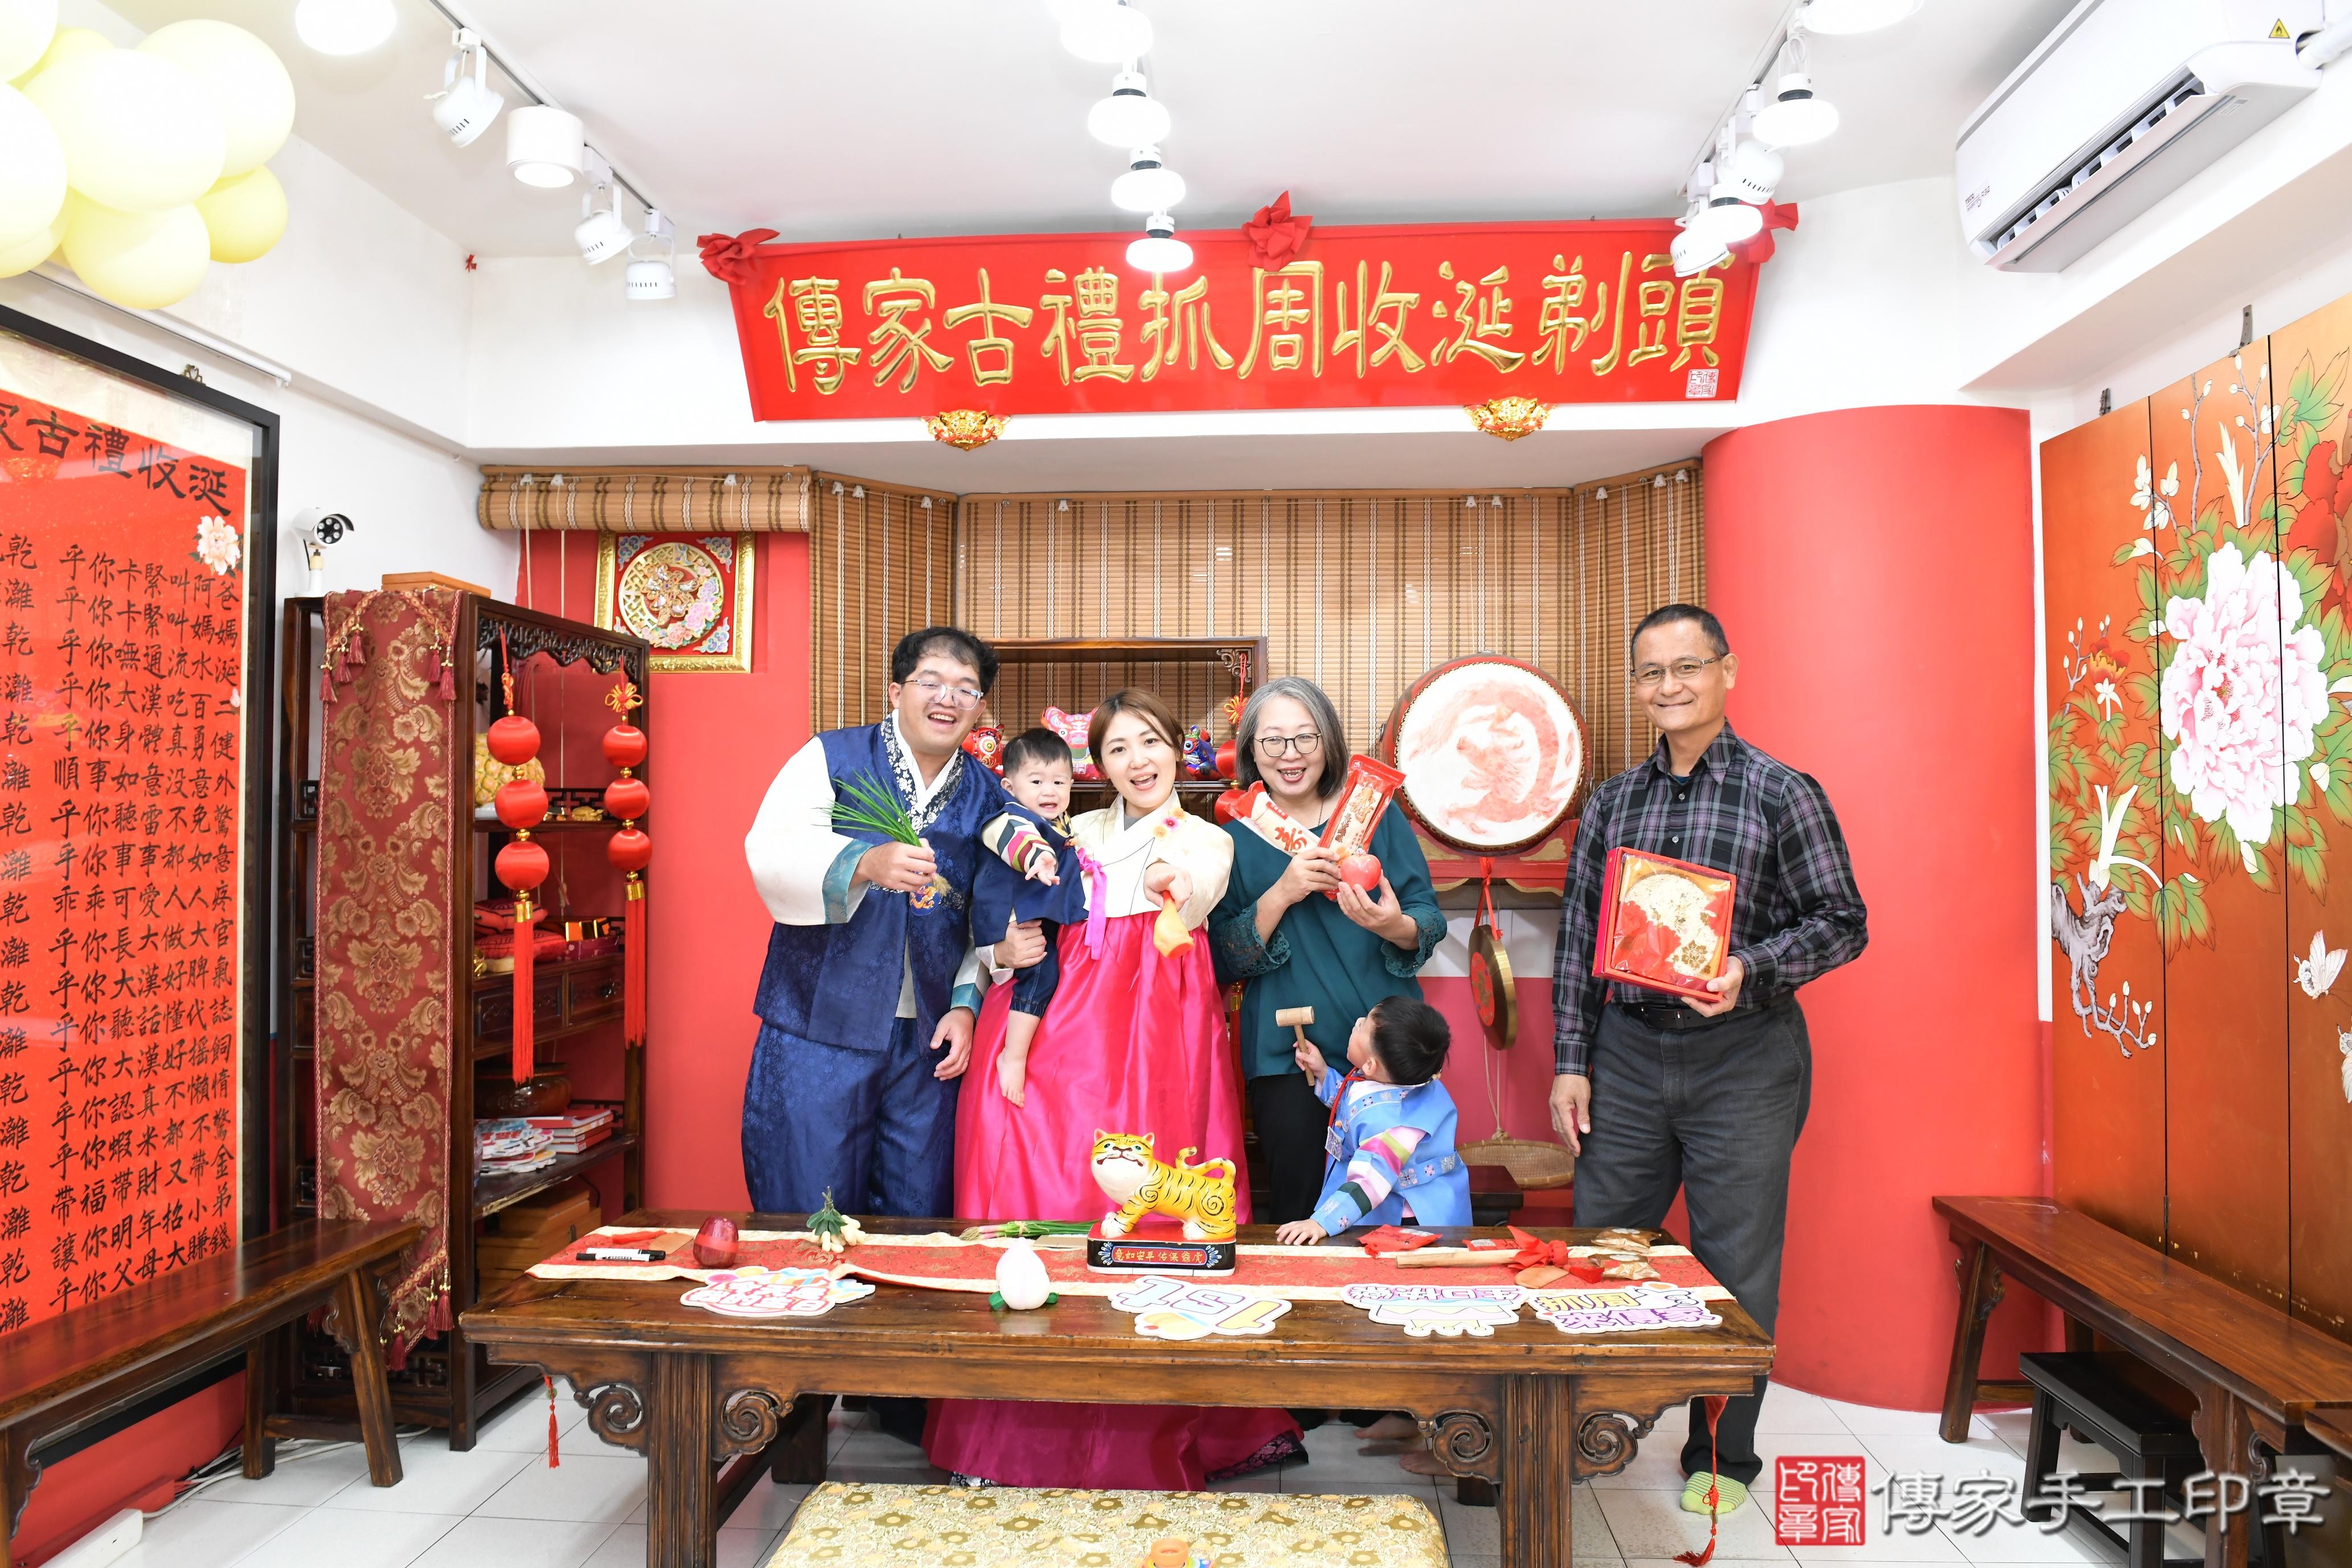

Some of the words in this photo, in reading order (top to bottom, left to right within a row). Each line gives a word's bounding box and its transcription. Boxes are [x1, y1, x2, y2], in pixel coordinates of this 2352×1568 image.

[763, 250, 1736, 395] 傳家古禮抓周收涎剃頭
[1534, 1292, 1642, 1312] 抓周
